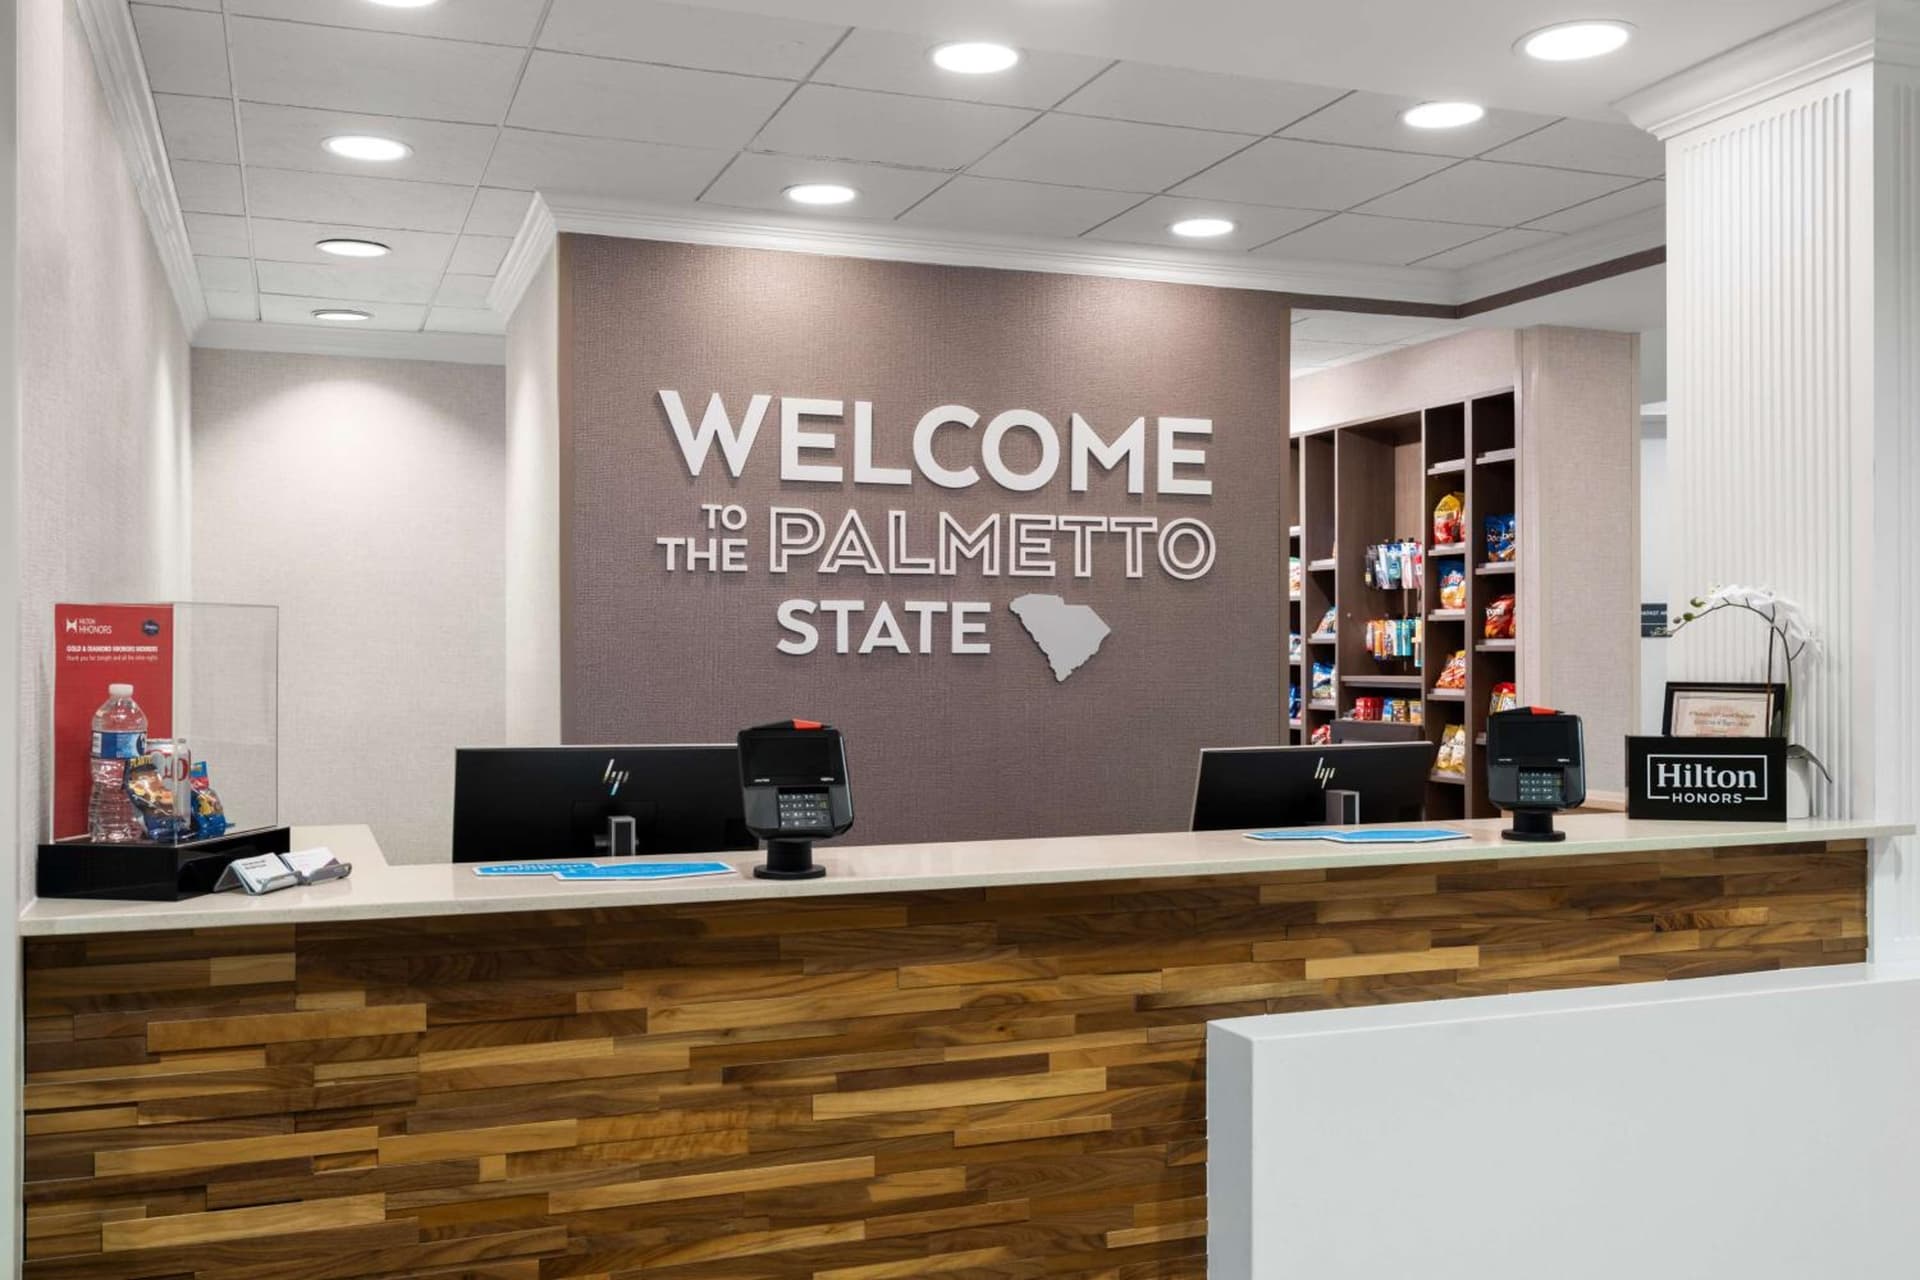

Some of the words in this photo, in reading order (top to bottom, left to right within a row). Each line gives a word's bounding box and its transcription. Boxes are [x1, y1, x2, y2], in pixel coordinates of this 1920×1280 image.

[659, 389, 1213, 495] WELCOME
[701, 503, 747, 530] TO
[656, 537, 748, 572] THE
[769, 506, 1216, 580] PALMETTO
[776, 599, 991, 655] STATE
[1314, 757, 1336, 789] hp
[1656, 763, 1758, 789] Hilton
[1672, 792, 1742, 804] HONORS
